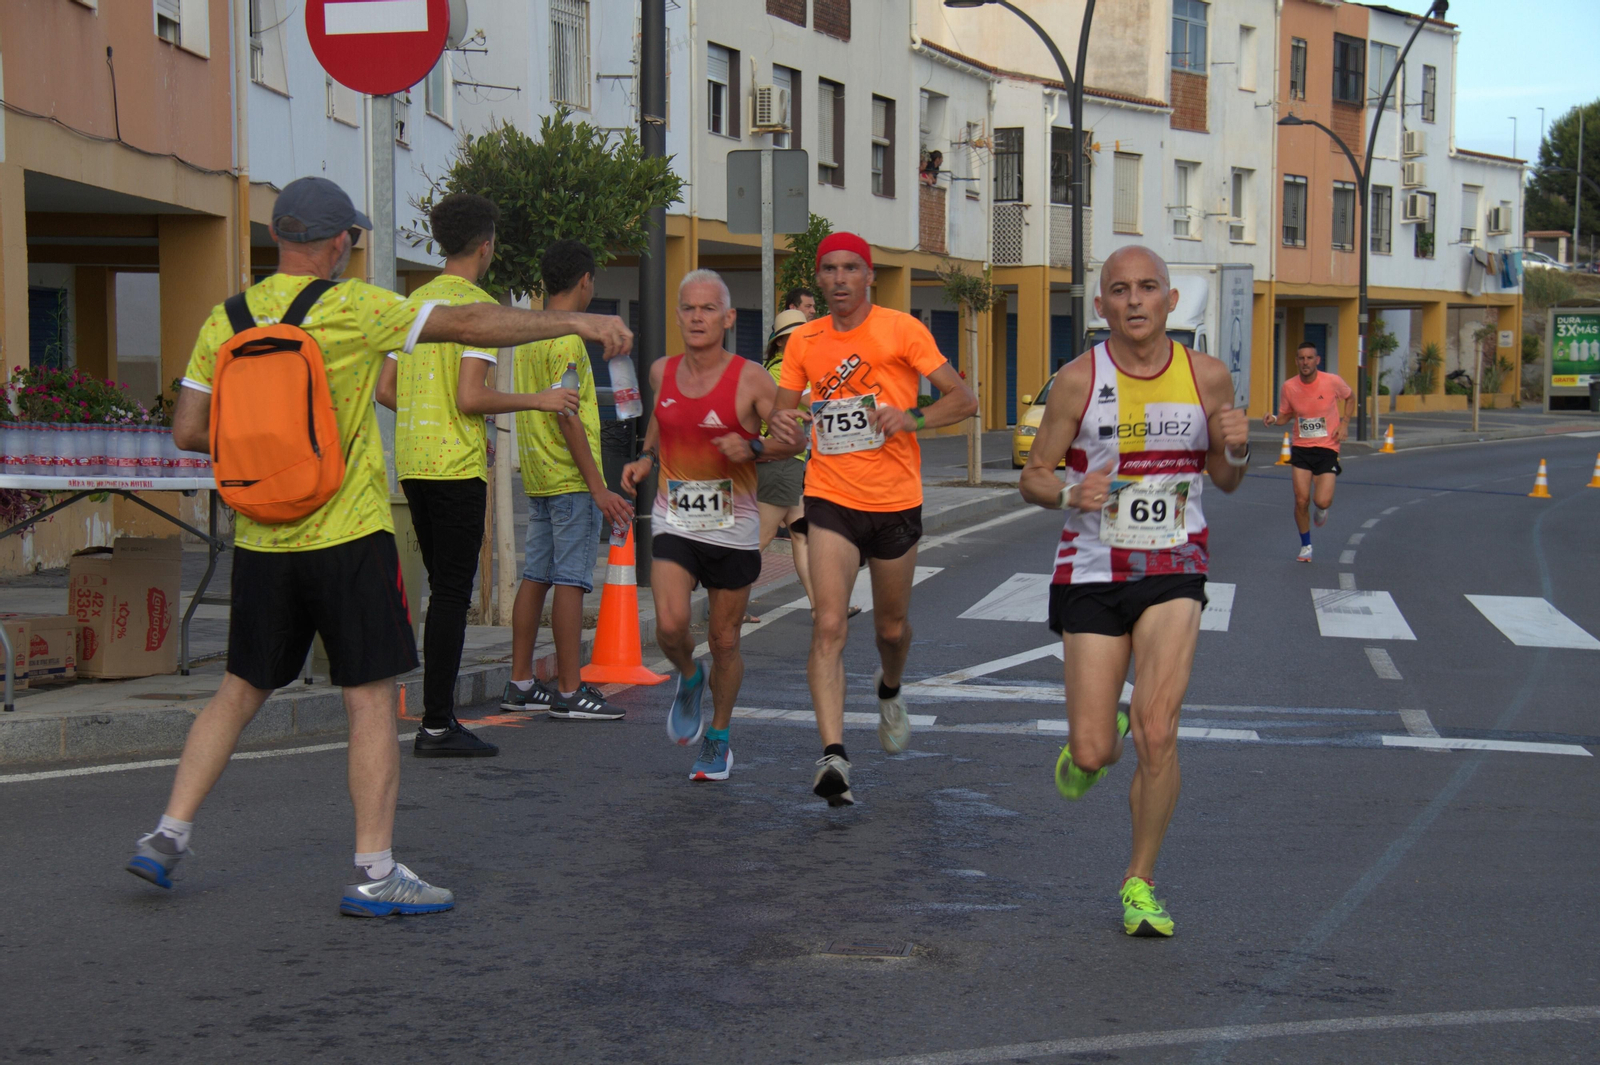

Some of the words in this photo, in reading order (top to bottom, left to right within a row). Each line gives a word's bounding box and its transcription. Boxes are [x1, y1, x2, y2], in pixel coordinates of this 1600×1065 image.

[1556, 324, 1577, 337] 3X
[1557, 316, 1581, 324] DURA
[819, 353, 861, 400] 2020
[823, 410, 868, 433] 753
[1302, 422, 1322, 431] 699
[678, 493, 719, 512] 441
[1130, 498, 1167, 524] 69
[76, 588, 91, 623] 33cl
[92, 592, 104, 608] 42
[116, 601, 130, 639] 100%
[151, 592, 164, 647] Lanjarón
